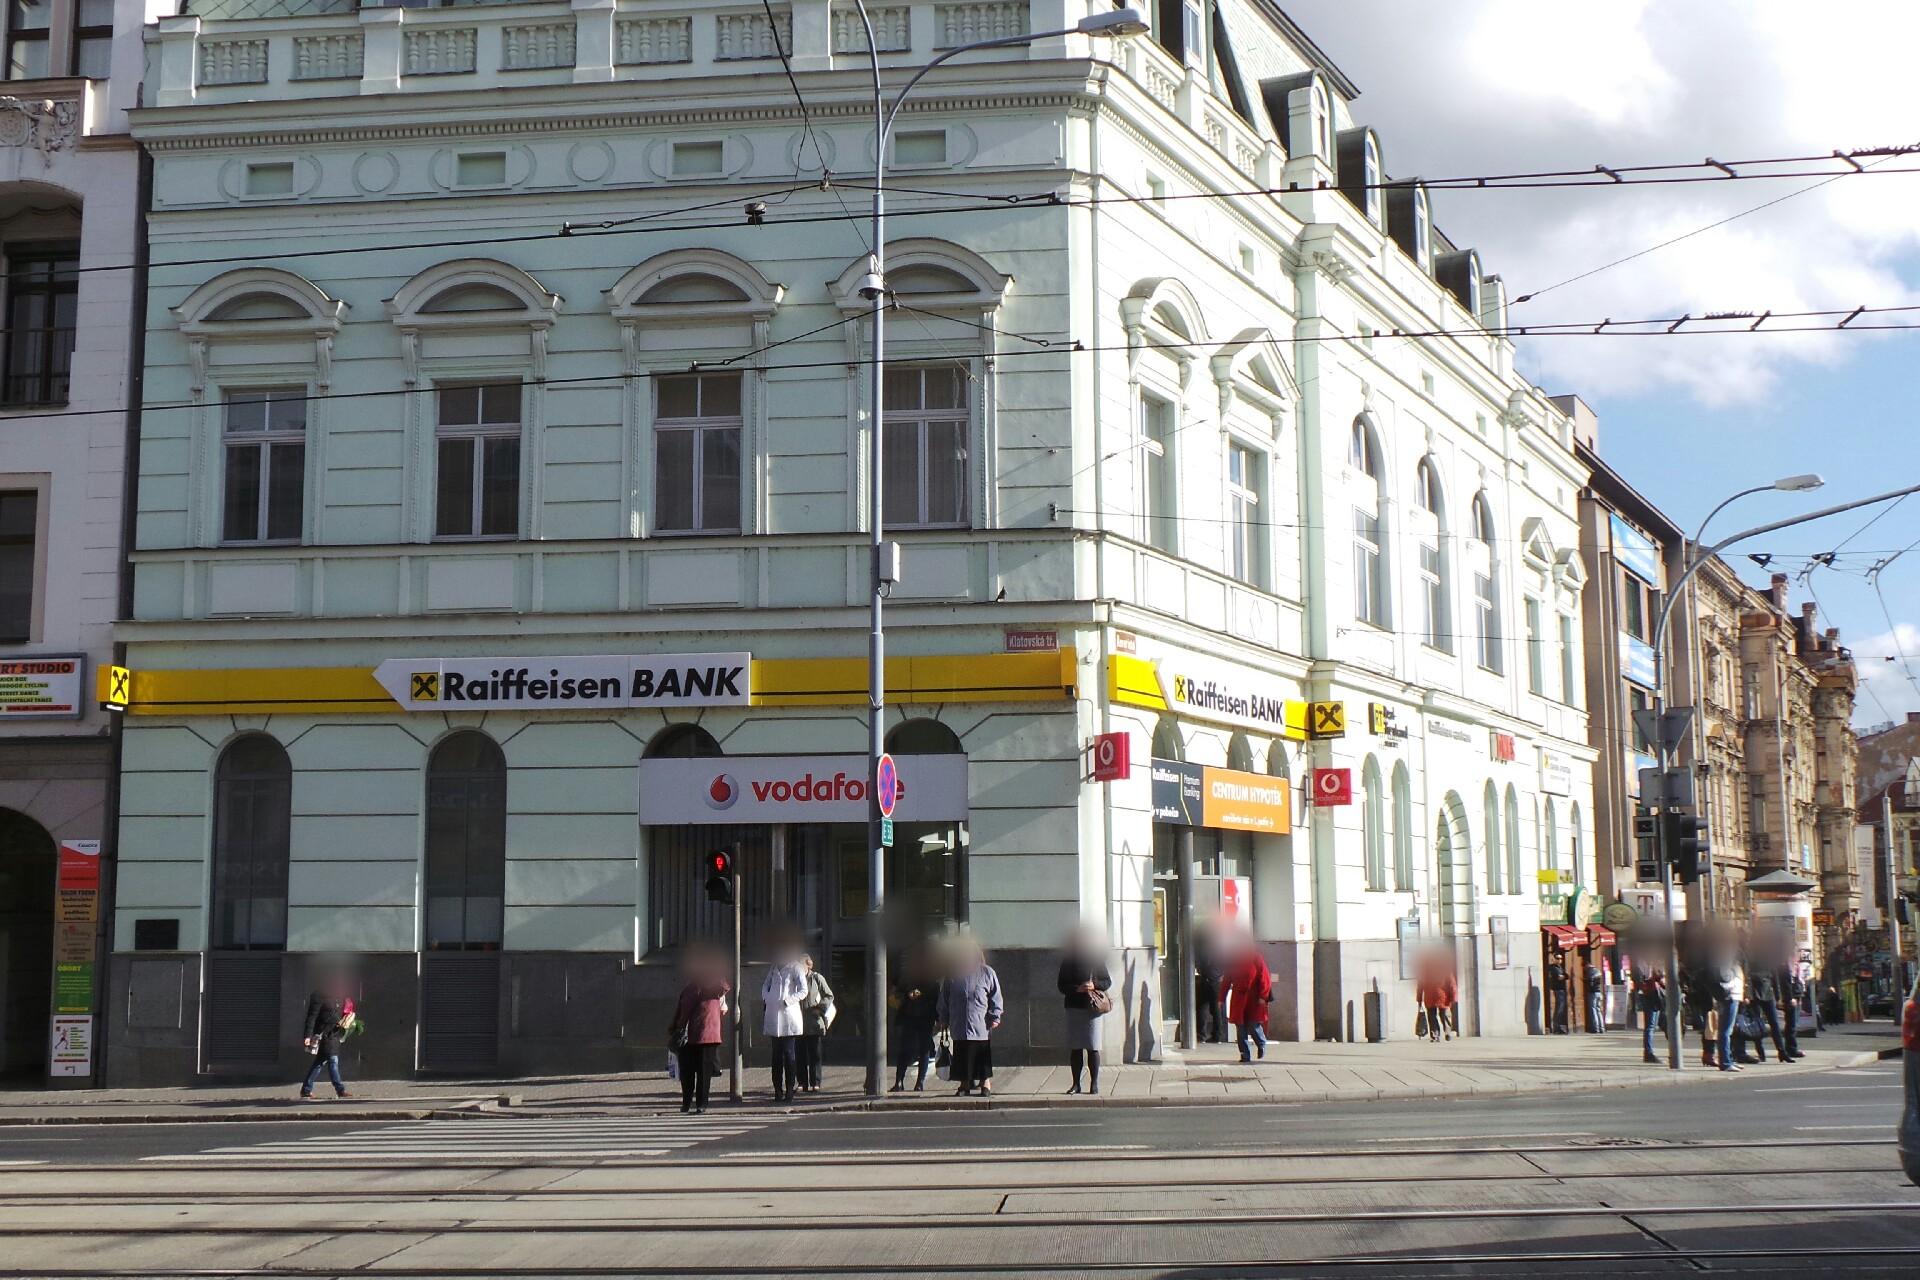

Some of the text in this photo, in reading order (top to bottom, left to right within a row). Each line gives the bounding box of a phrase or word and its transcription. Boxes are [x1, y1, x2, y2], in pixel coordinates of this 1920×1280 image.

[1008, 634, 1044, 648] Klatovská
[21, 662, 71, 674] STUDIO
[443, 666, 744, 701] Raiffeisen BANK
[1187, 678, 1283, 725] Raiffeisen BANK
[751, 773, 905, 802] vodafo
[1212, 780, 1249, 802] CENTRUM
